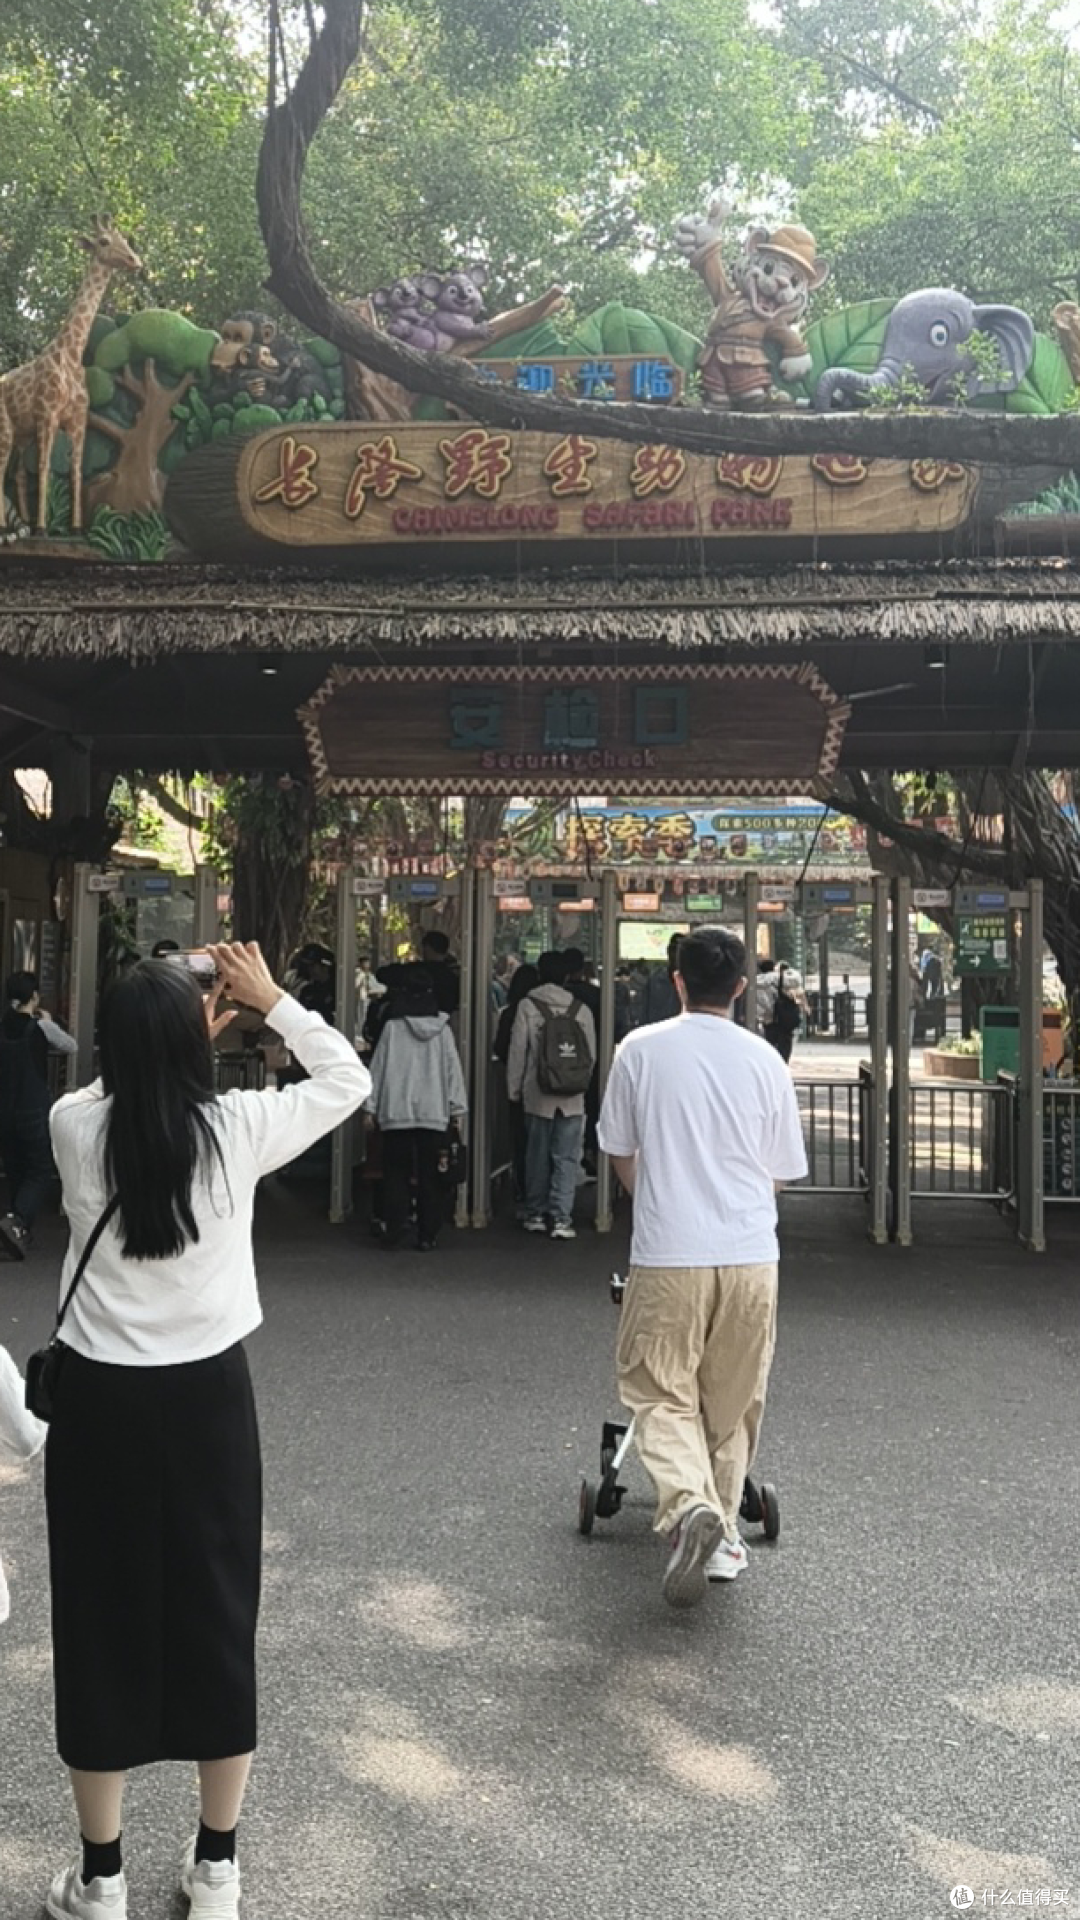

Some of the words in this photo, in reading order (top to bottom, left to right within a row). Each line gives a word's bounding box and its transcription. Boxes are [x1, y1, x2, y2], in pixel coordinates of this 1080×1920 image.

[477, 360, 674, 400] 迎光临
[392, 502, 560, 535] CHIMELONG
[583, 500, 696, 531] SAFARI
[711, 498, 793, 528] PARK
[450, 685, 689, 748] 安检口
[481, 751, 583, 771] Security
[588, 748, 657, 768] Check
